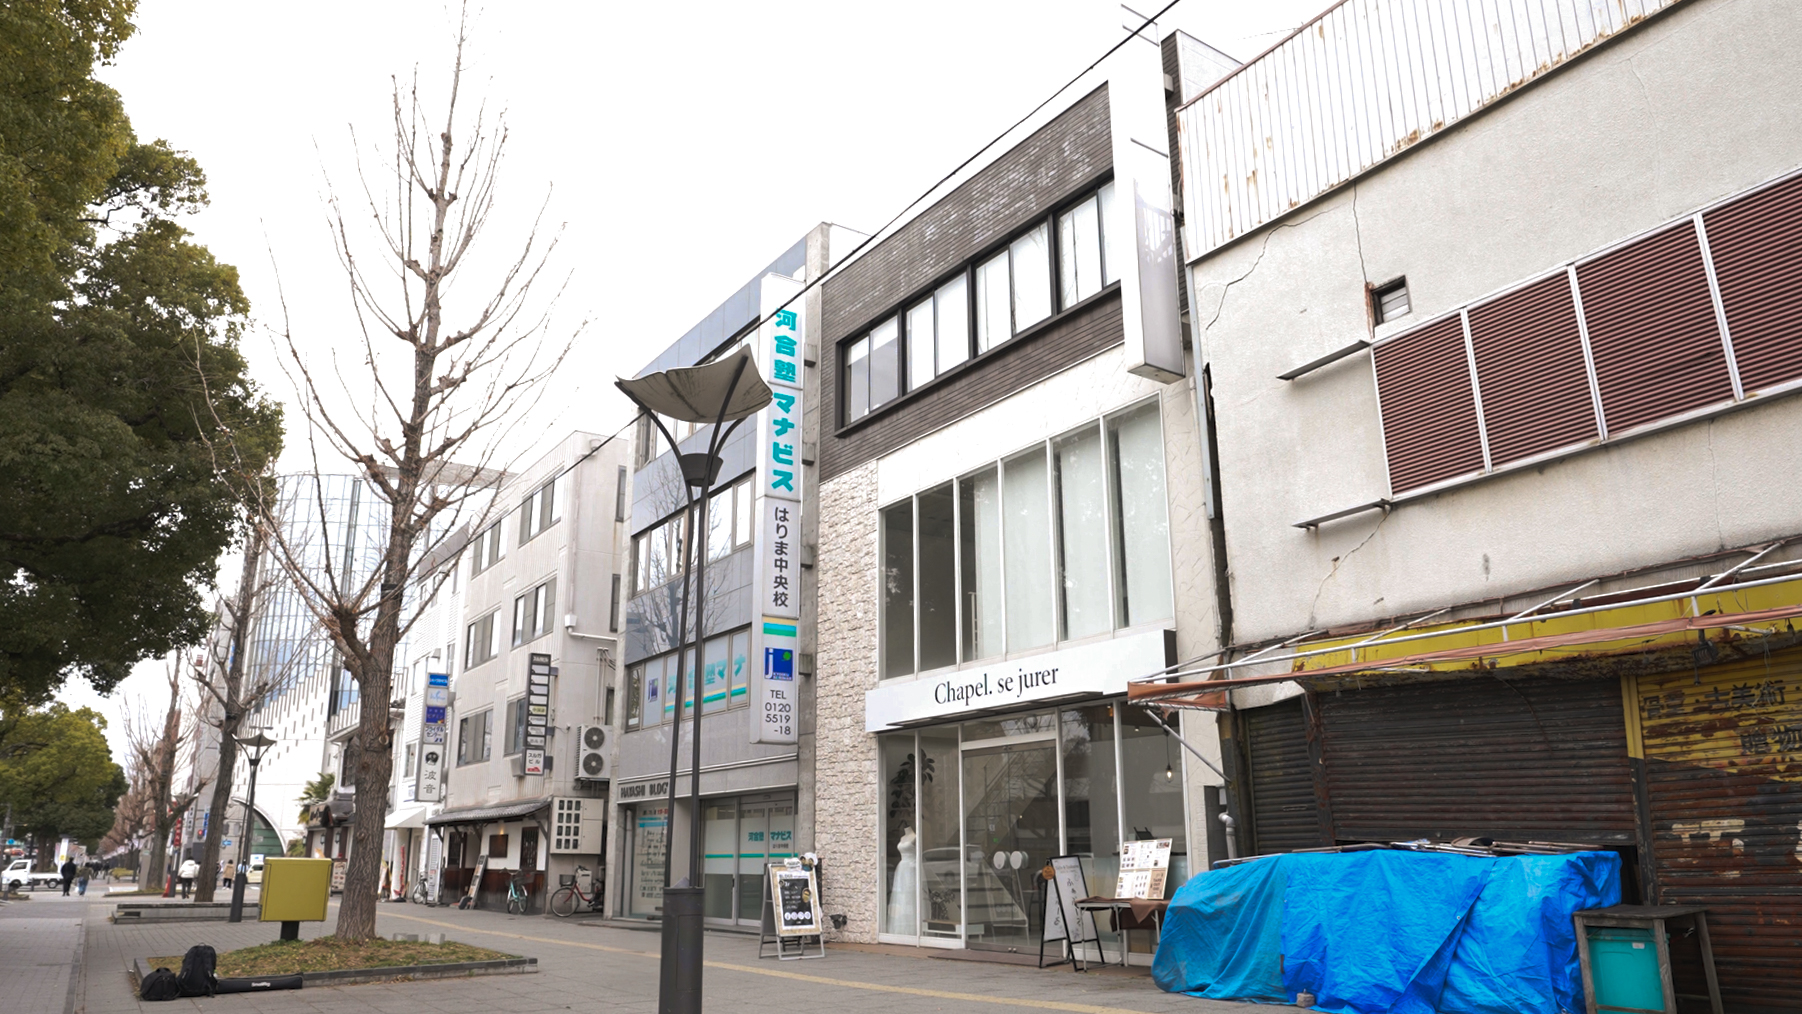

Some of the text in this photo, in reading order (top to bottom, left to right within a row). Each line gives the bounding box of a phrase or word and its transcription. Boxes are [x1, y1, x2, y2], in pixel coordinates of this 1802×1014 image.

[772, 506, 789, 608] はりま中央校
[934, 668, 1059, 706] Chapel. se jurer
[770, 689, 787, 700] TEL
[764, 702, 792, 713] 0120
[764, 714, 791, 724] 5519
[773, 725, 791, 736] -18
[423, 770, 437, 794] 波音
[620, 784, 646, 799] HAYASHI
[770, 830, 792, 841] マナビス
